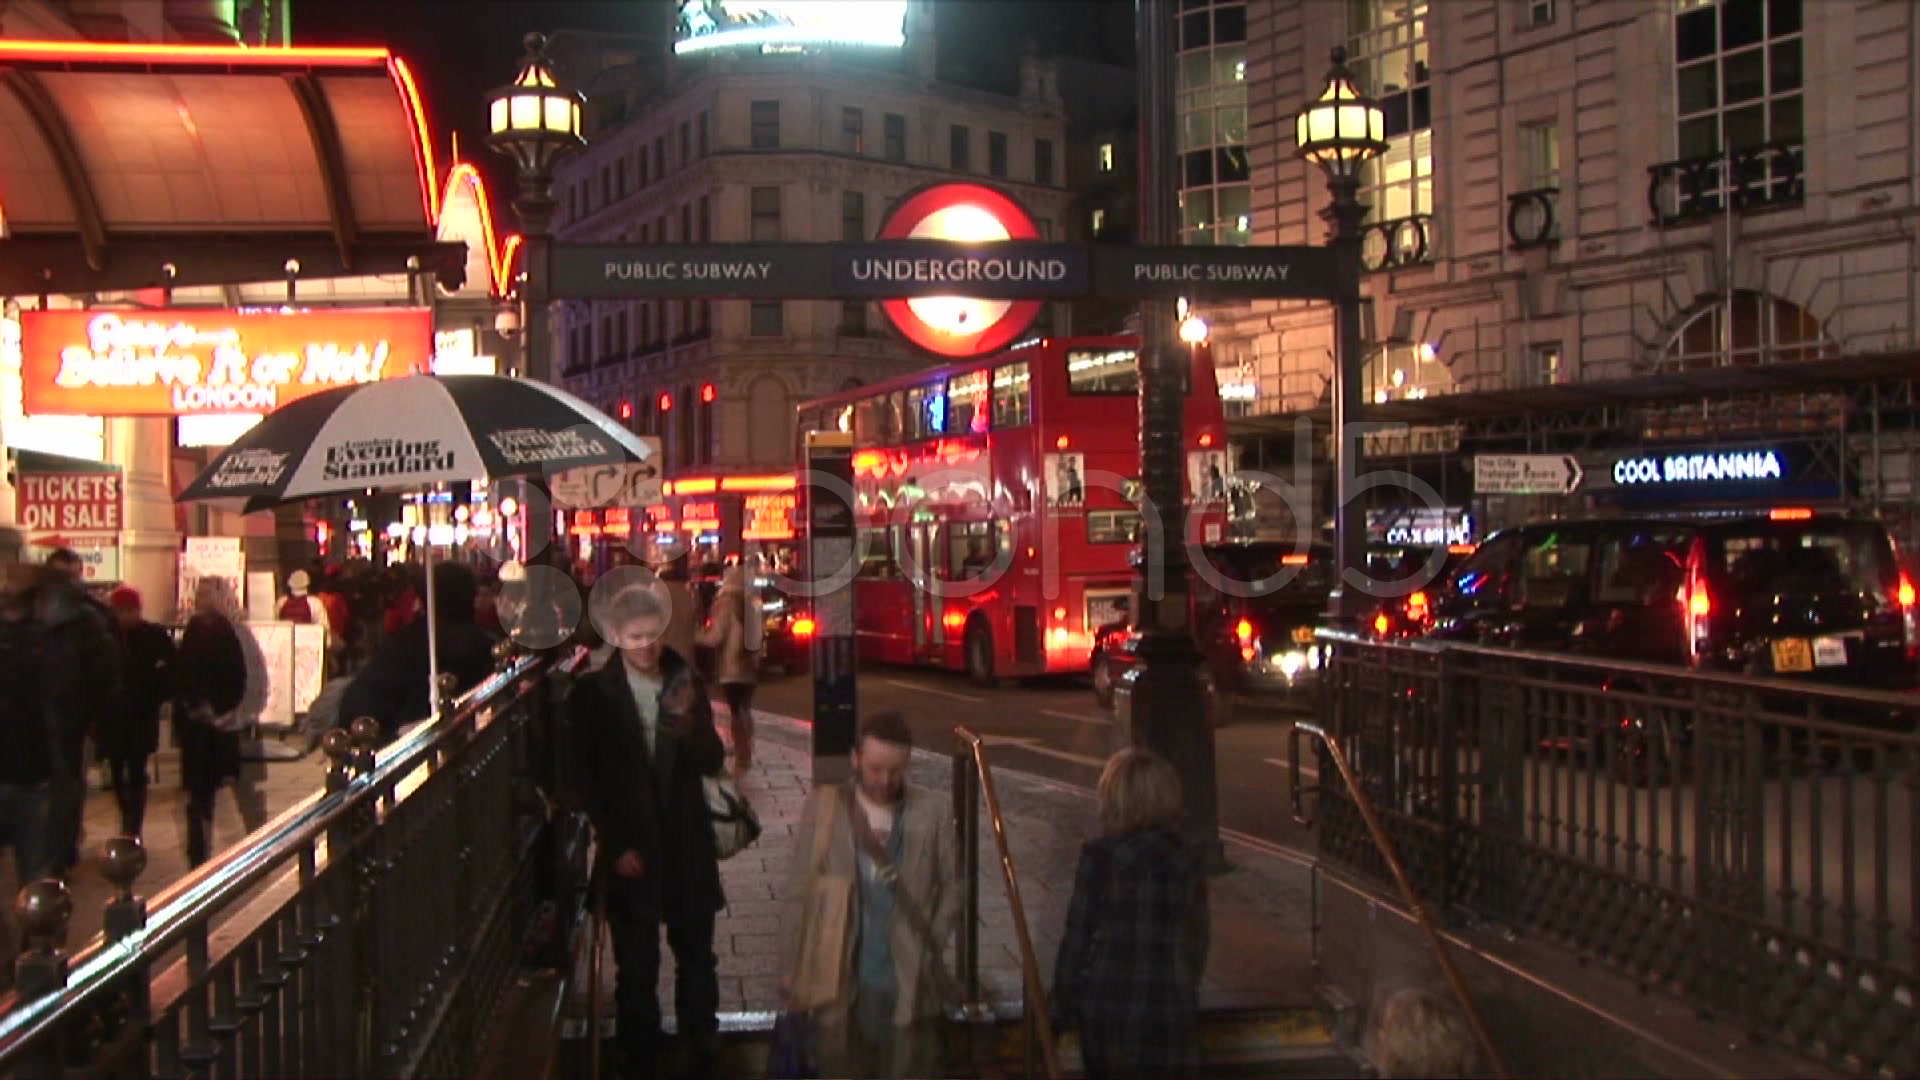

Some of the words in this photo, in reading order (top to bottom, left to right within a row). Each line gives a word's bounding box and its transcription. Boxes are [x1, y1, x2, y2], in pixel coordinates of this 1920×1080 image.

[605, 262, 676, 281] PUBLIC
[682, 262, 772, 281] SUBWAY
[852, 258, 1067, 284] UNDERGROUND
[1134, 263, 1203, 281] PUBLIC
[1208, 263, 1290, 282] SUBWAY
[56, 345, 200, 388] Believe
[207, 343, 248, 386] It
[251, 351, 299, 385] or
[300, 339, 390, 385] Not!
[172, 384, 277, 410] LONDON
[326, 439, 440, 464] Evening
[323, 450, 455, 481] Standard
[1614, 457, 1662, 484] COOL
[1663, 451, 1781, 482] BRITANNIA
[22, 476, 117, 501] TICKETS
[23, 503, 57, 529] ON
[62, 503, 117, 529] SALE
